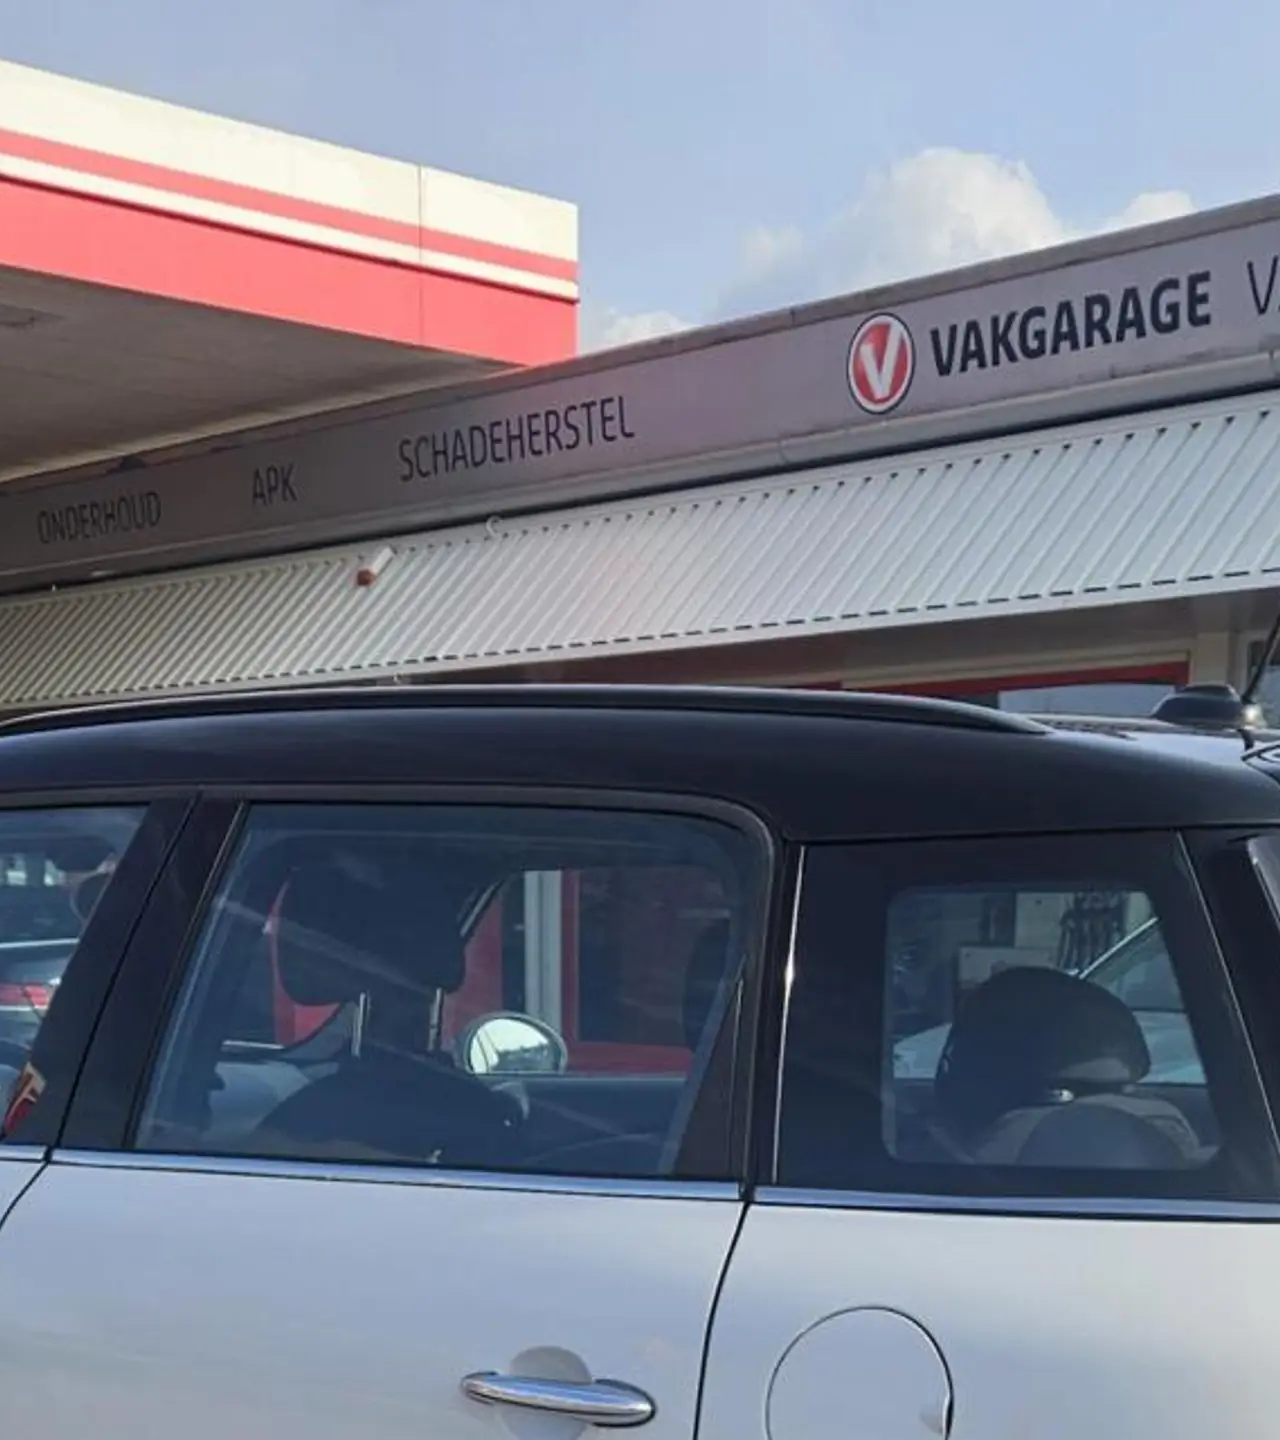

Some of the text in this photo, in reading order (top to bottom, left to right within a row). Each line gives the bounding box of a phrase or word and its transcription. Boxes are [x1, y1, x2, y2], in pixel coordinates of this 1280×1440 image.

[930, 270, 1212, 377] VAKGARAGE
[398, 396, 635, 483] SCHADEHERSTEL
[36, 489, 162, 545] ONDERHOUD
[251, 464, 297, 506] APK
